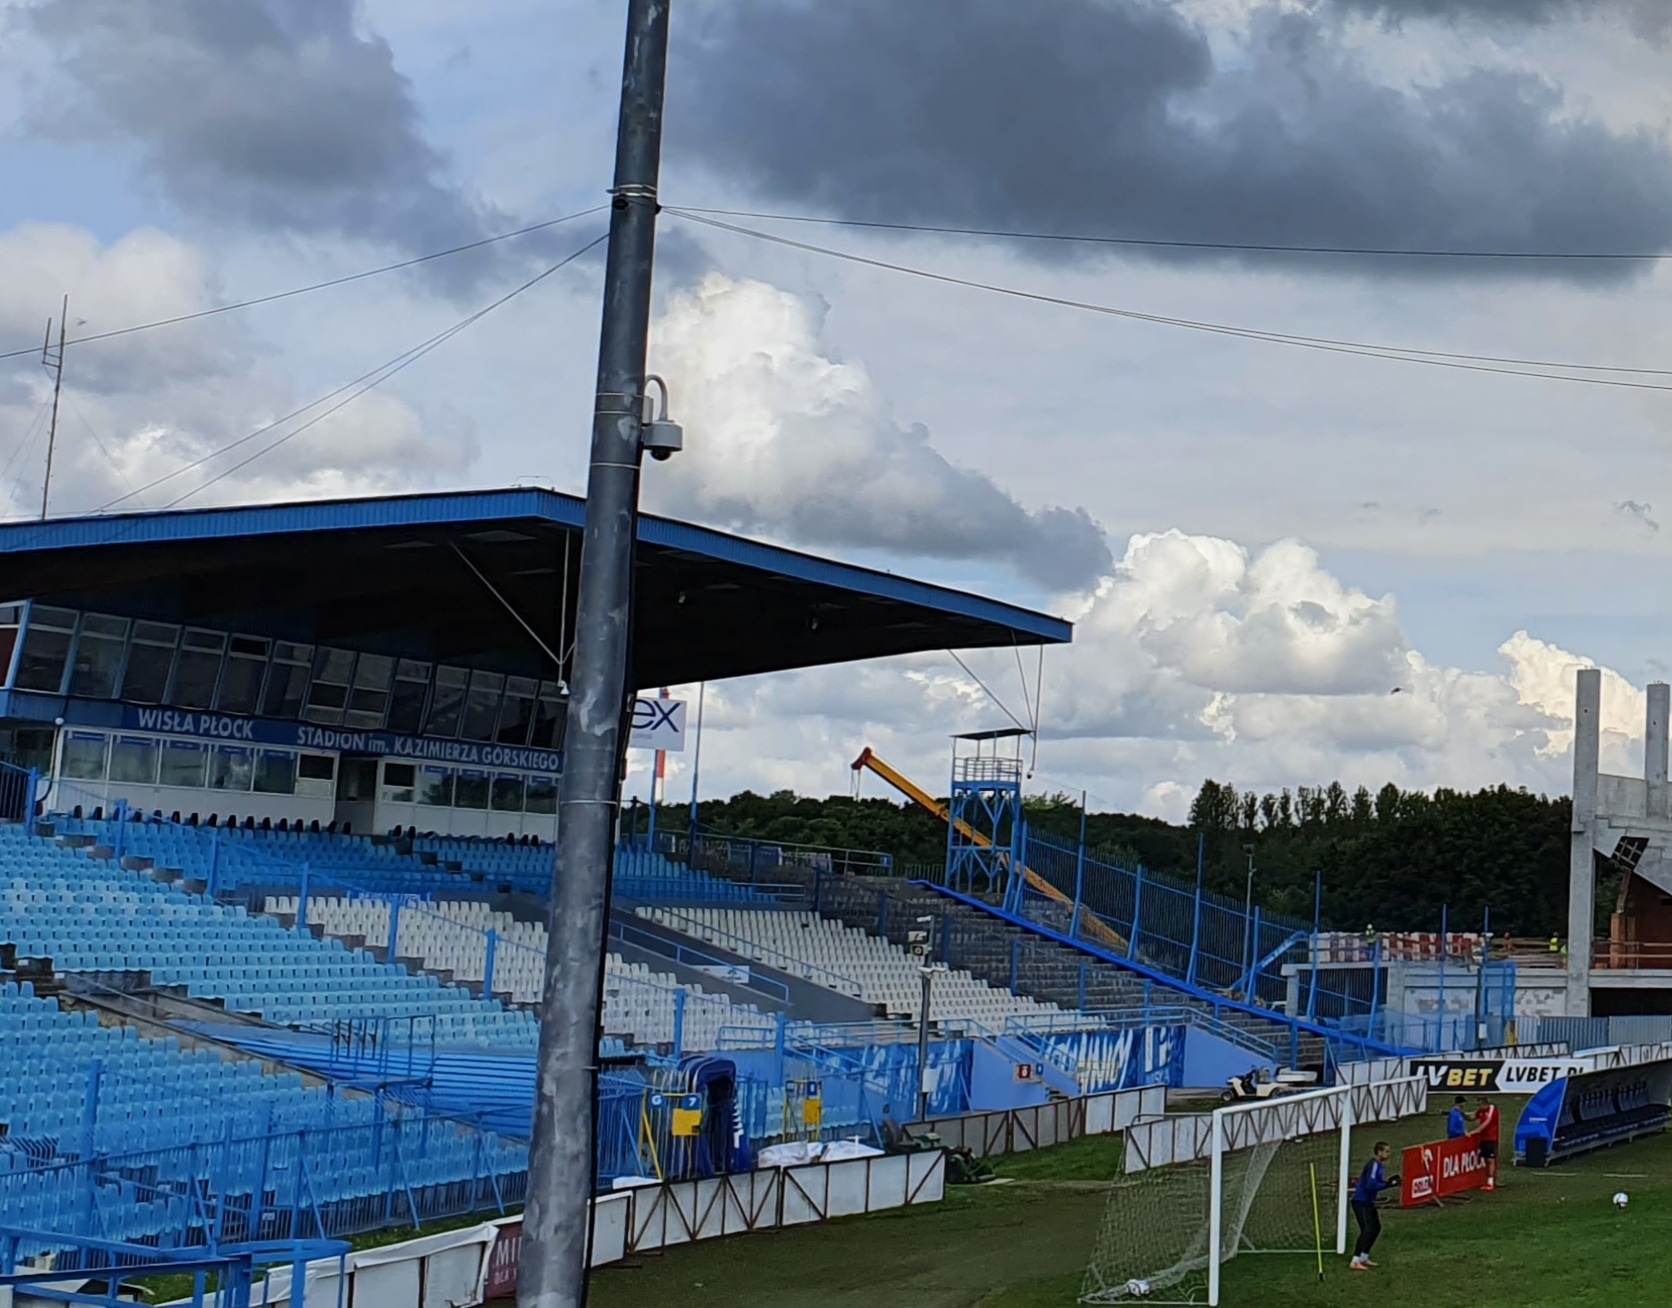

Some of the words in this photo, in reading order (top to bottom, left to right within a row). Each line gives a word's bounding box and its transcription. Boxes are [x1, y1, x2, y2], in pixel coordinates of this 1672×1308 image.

[138, 708, 194, 732] WISŁA
[200, 715, 254, 739] PŁOCK
[297, 726, 365, 750] STADION
[394, 736, 479, 762] KAZIMIERZA
[1506, 1067, 1584, 1082] LVBETP
[1443, 1154, 1460, 1178] DLA
